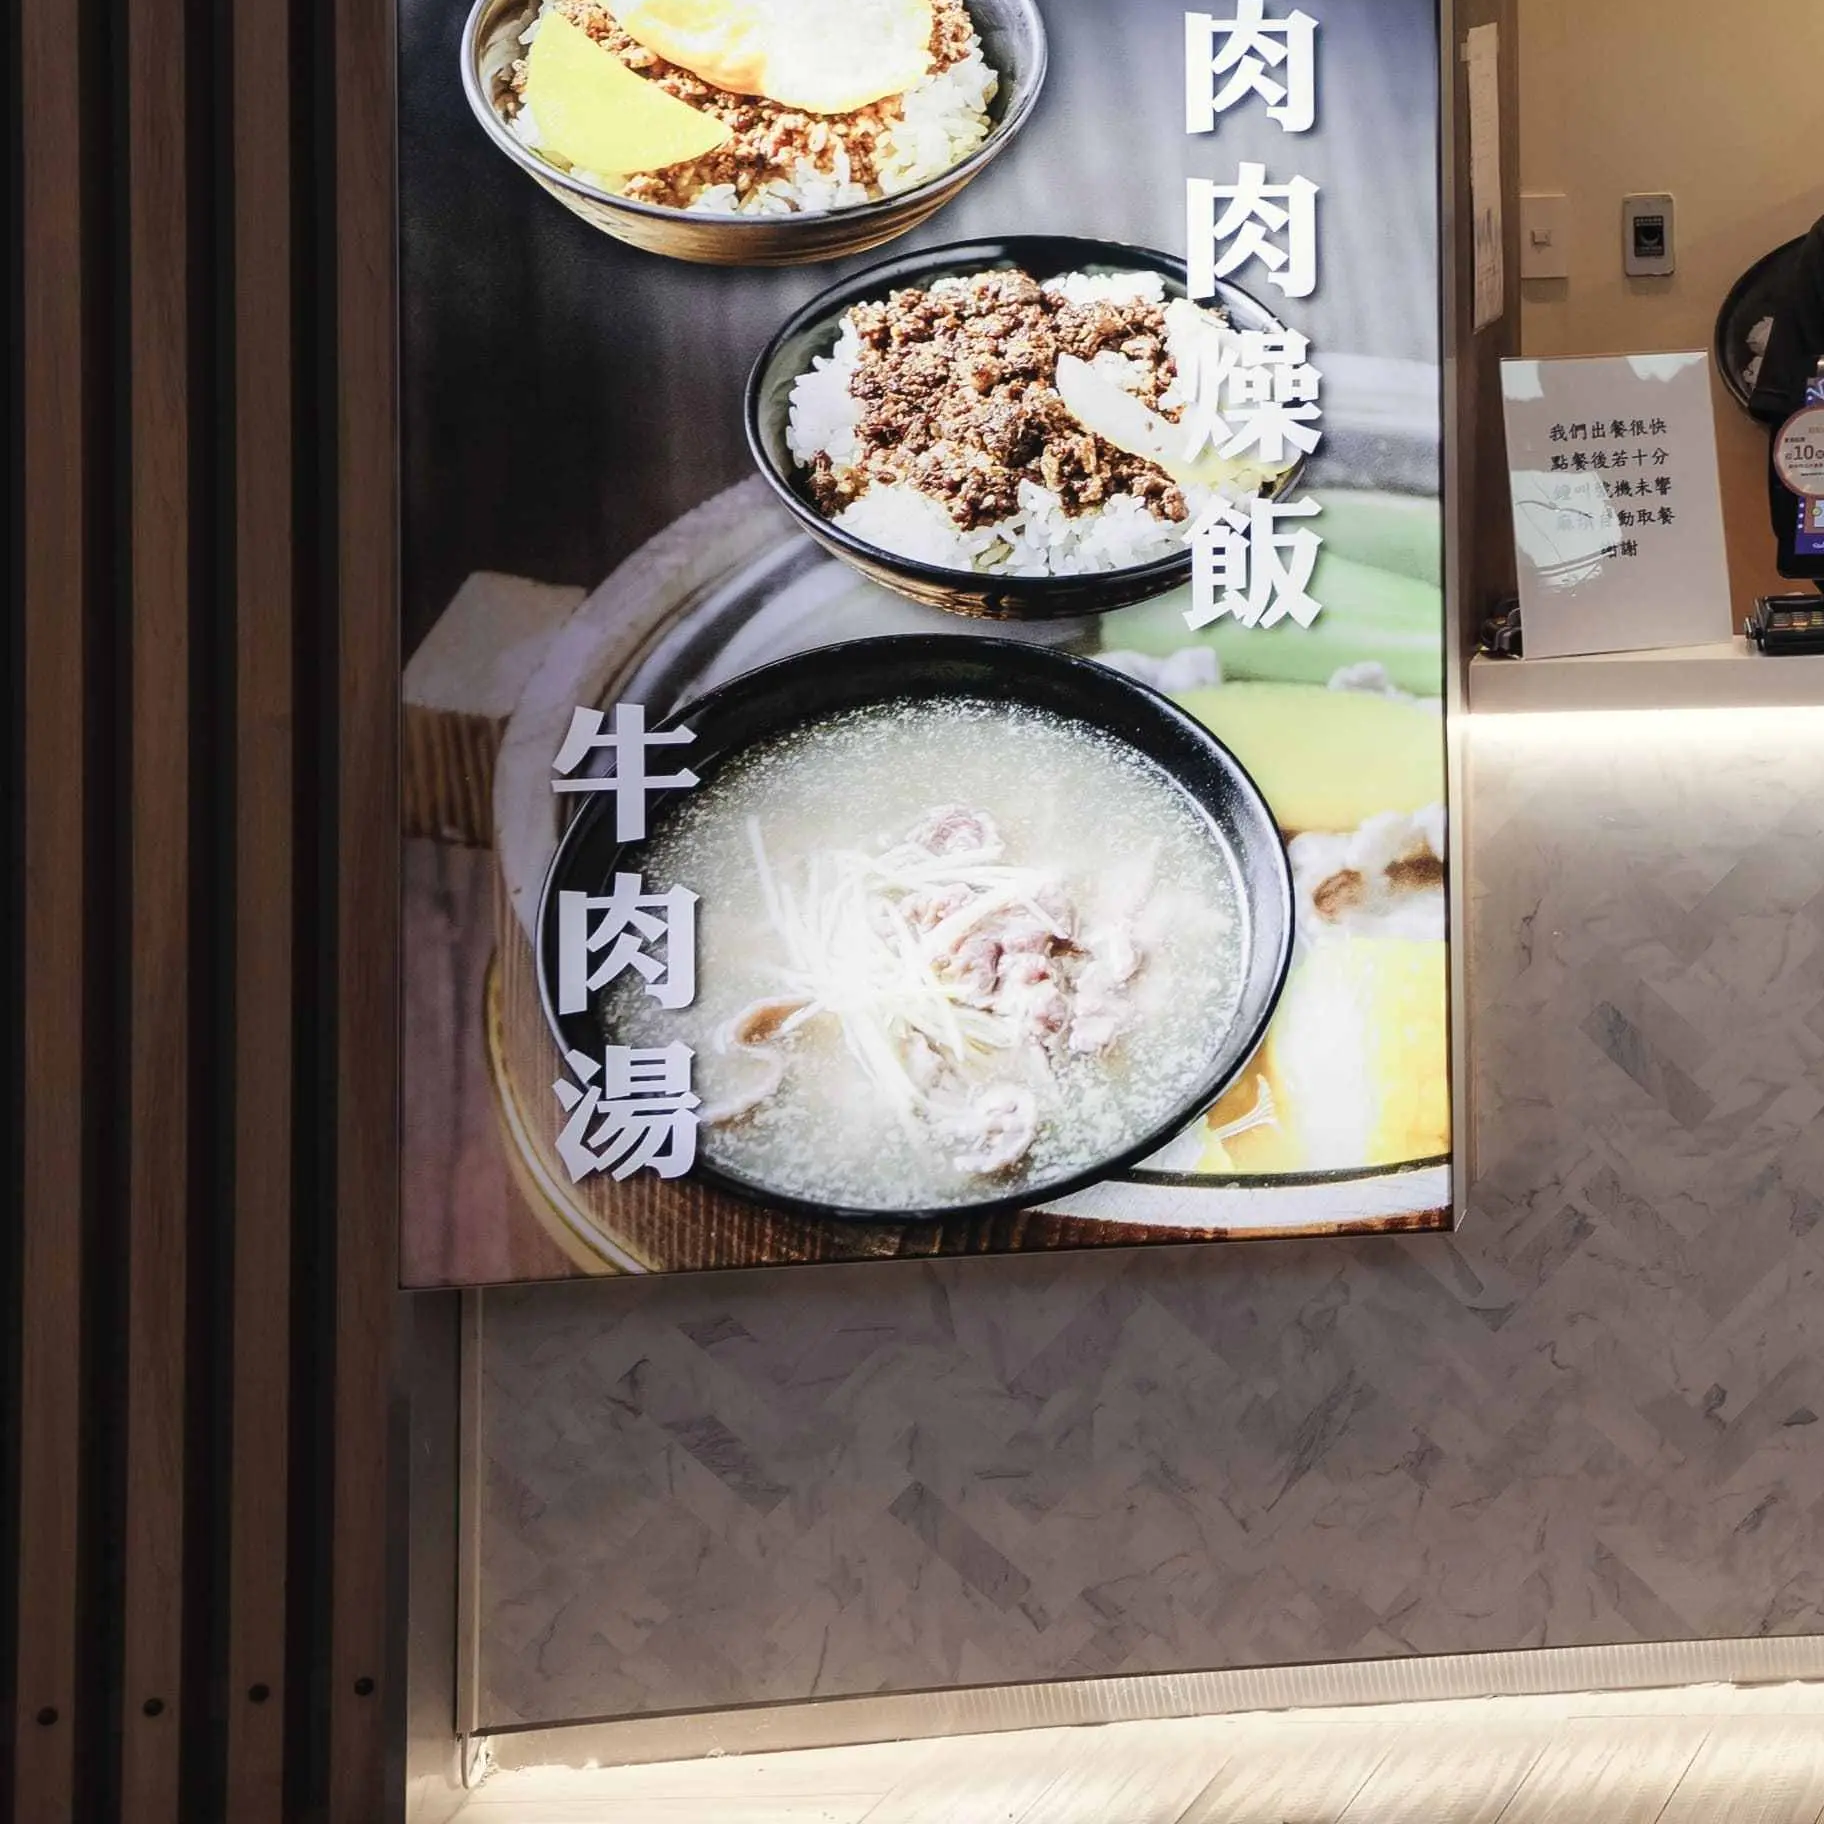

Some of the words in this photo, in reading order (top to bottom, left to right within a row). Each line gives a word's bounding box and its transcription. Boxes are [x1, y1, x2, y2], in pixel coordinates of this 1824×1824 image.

[1548, 416, 1668, 443] 我們出餐很快
[1549, 446, 1670, 473] 點餐後若十分
[549, 703, 701, 1184] 牛肉湯
